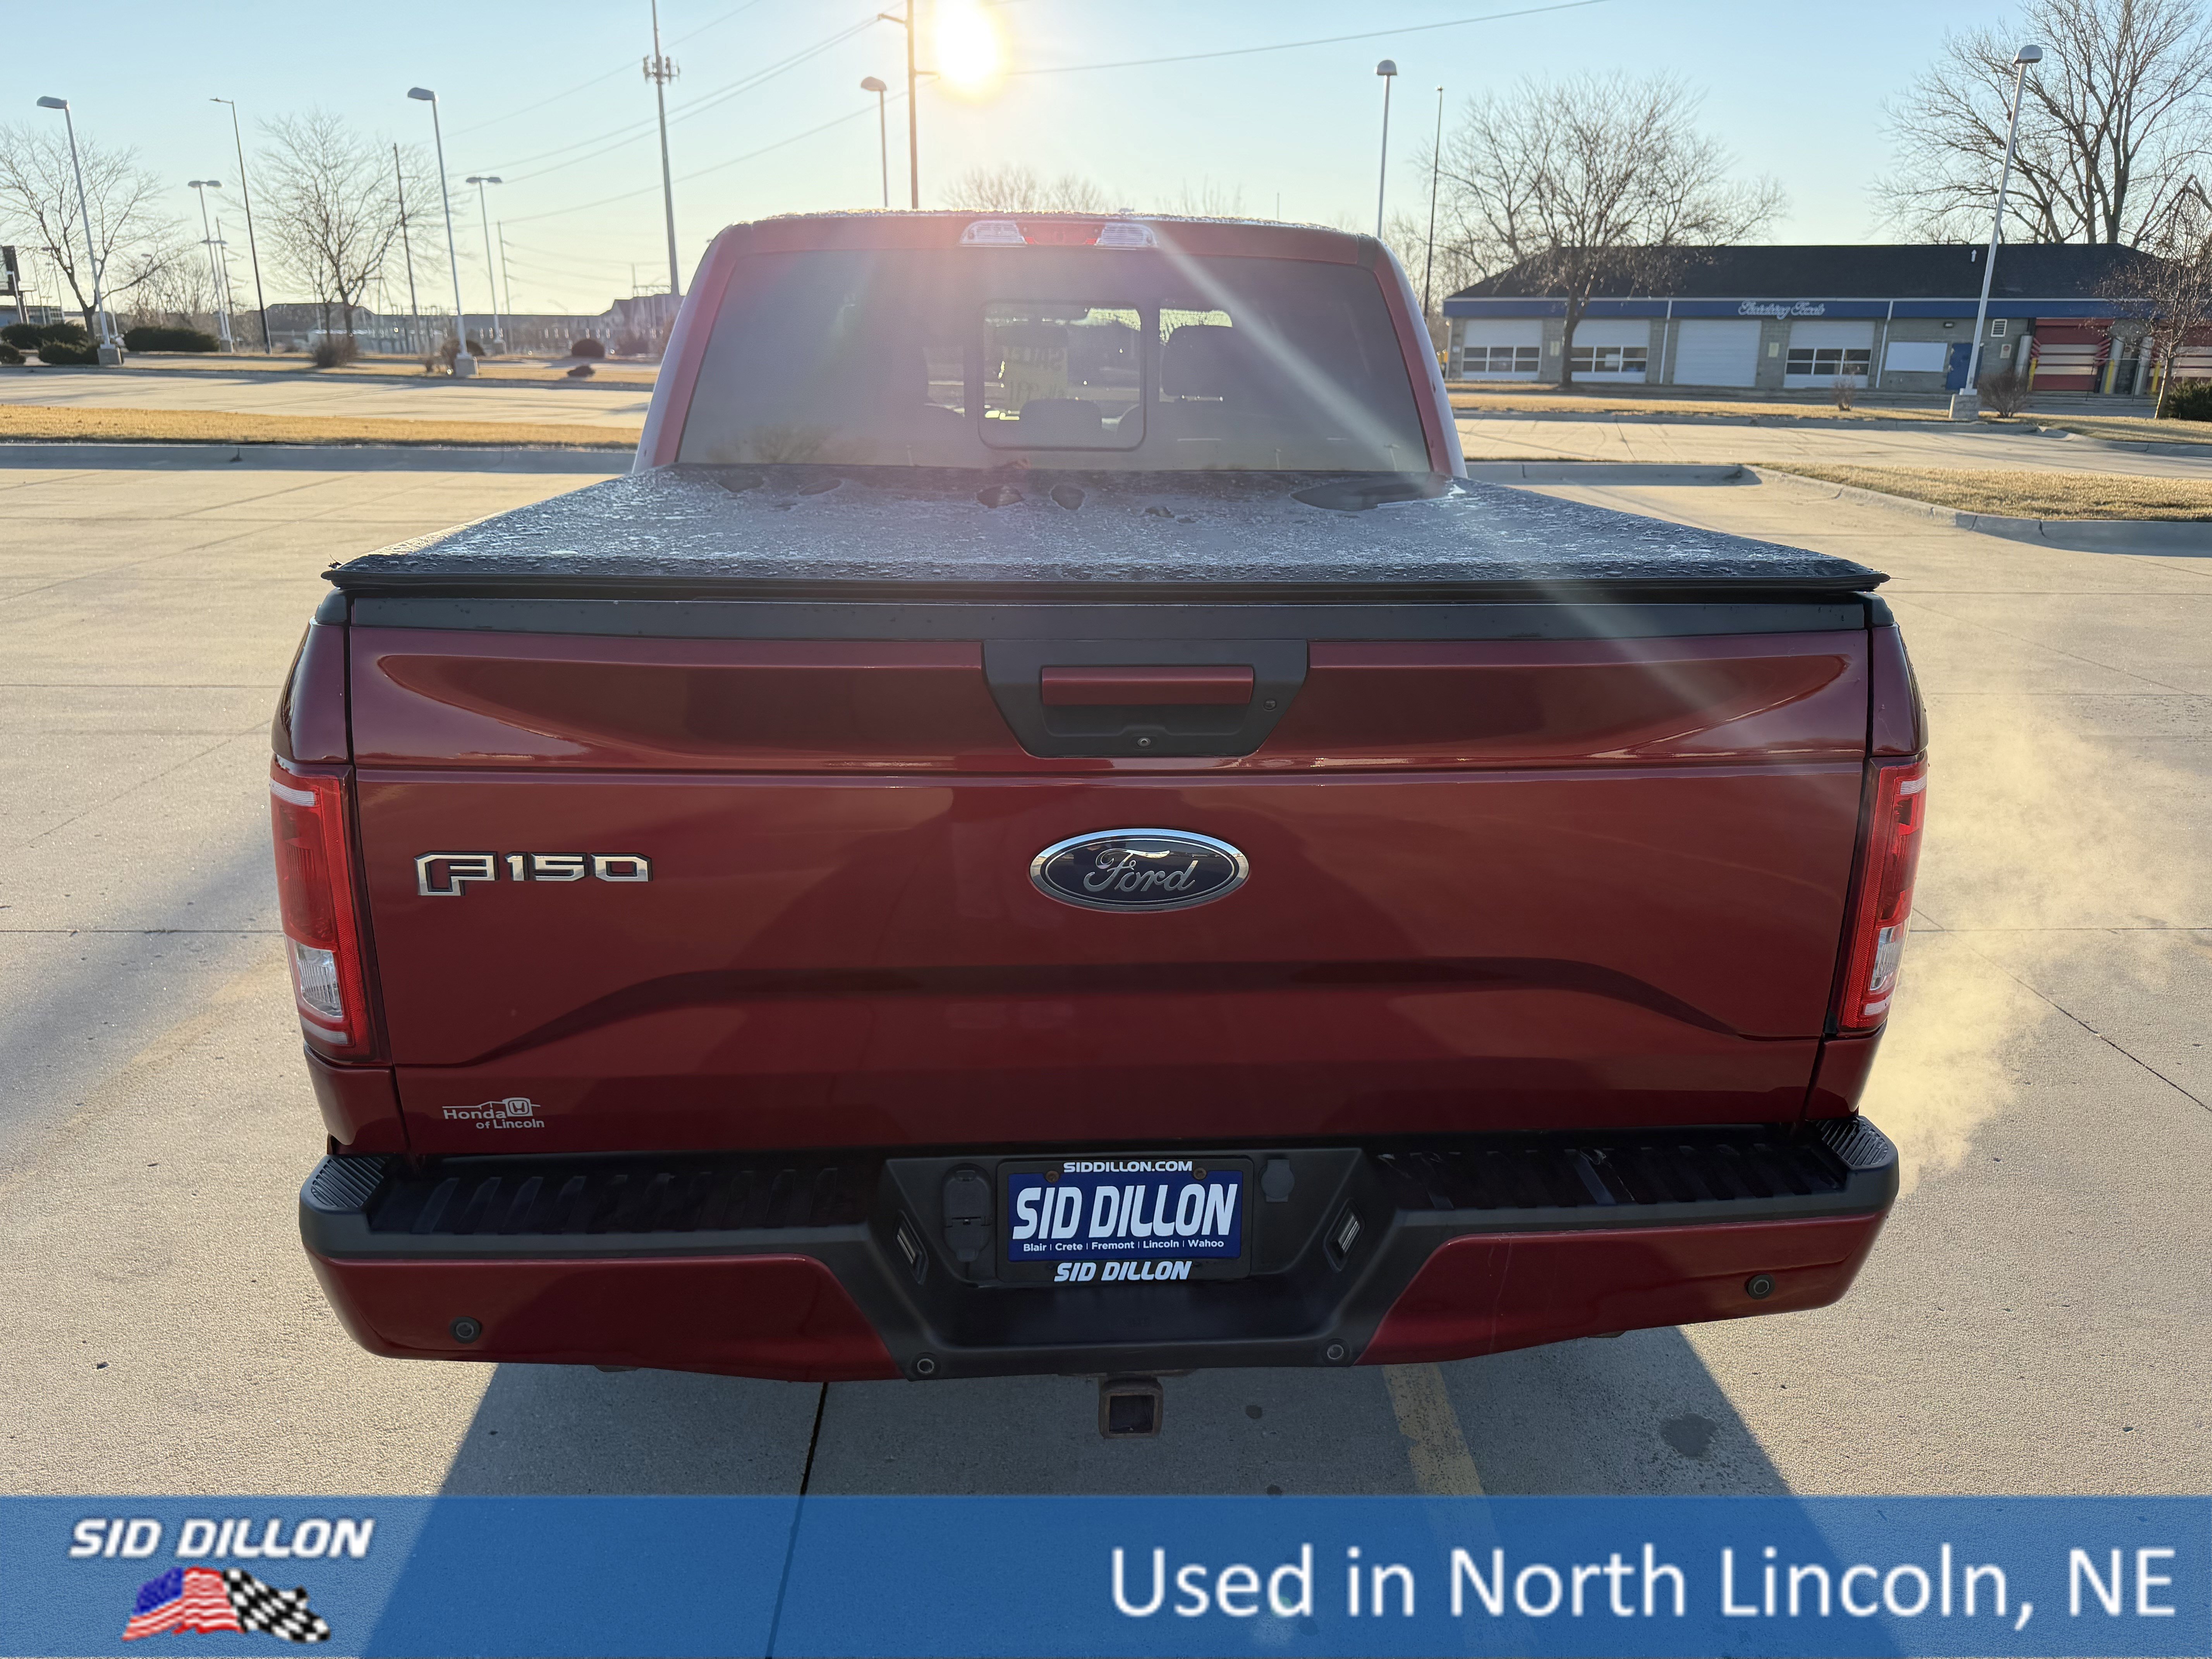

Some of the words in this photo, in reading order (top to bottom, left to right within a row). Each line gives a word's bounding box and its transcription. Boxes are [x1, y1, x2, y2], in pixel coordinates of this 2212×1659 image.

[1084, 848, 1199, 892] Ford
[443, 1109, 507, 1119] Honda
[493, 1118, 544, 1129] Lincoln
[1063, 1161, 1192, 1173] SIDDILLON.COM
[1012, 1187, 1082, 1240] SID
[1088, 1183, 1238, 1238] DILLON
[1024, 1243, 1047, 1252] Blair
[1055, 1243, 1083, 1251] Crete
[1092, 1241, 1135, 1250] Fremont
[1143, 1240, 1179, 1249] Lincoln
[1188, 1239, 1224, 1247] Wahoo
[1054, 1262, 1096, 1282] SID
[1101, 1261, 1192, 1281] DILLON
